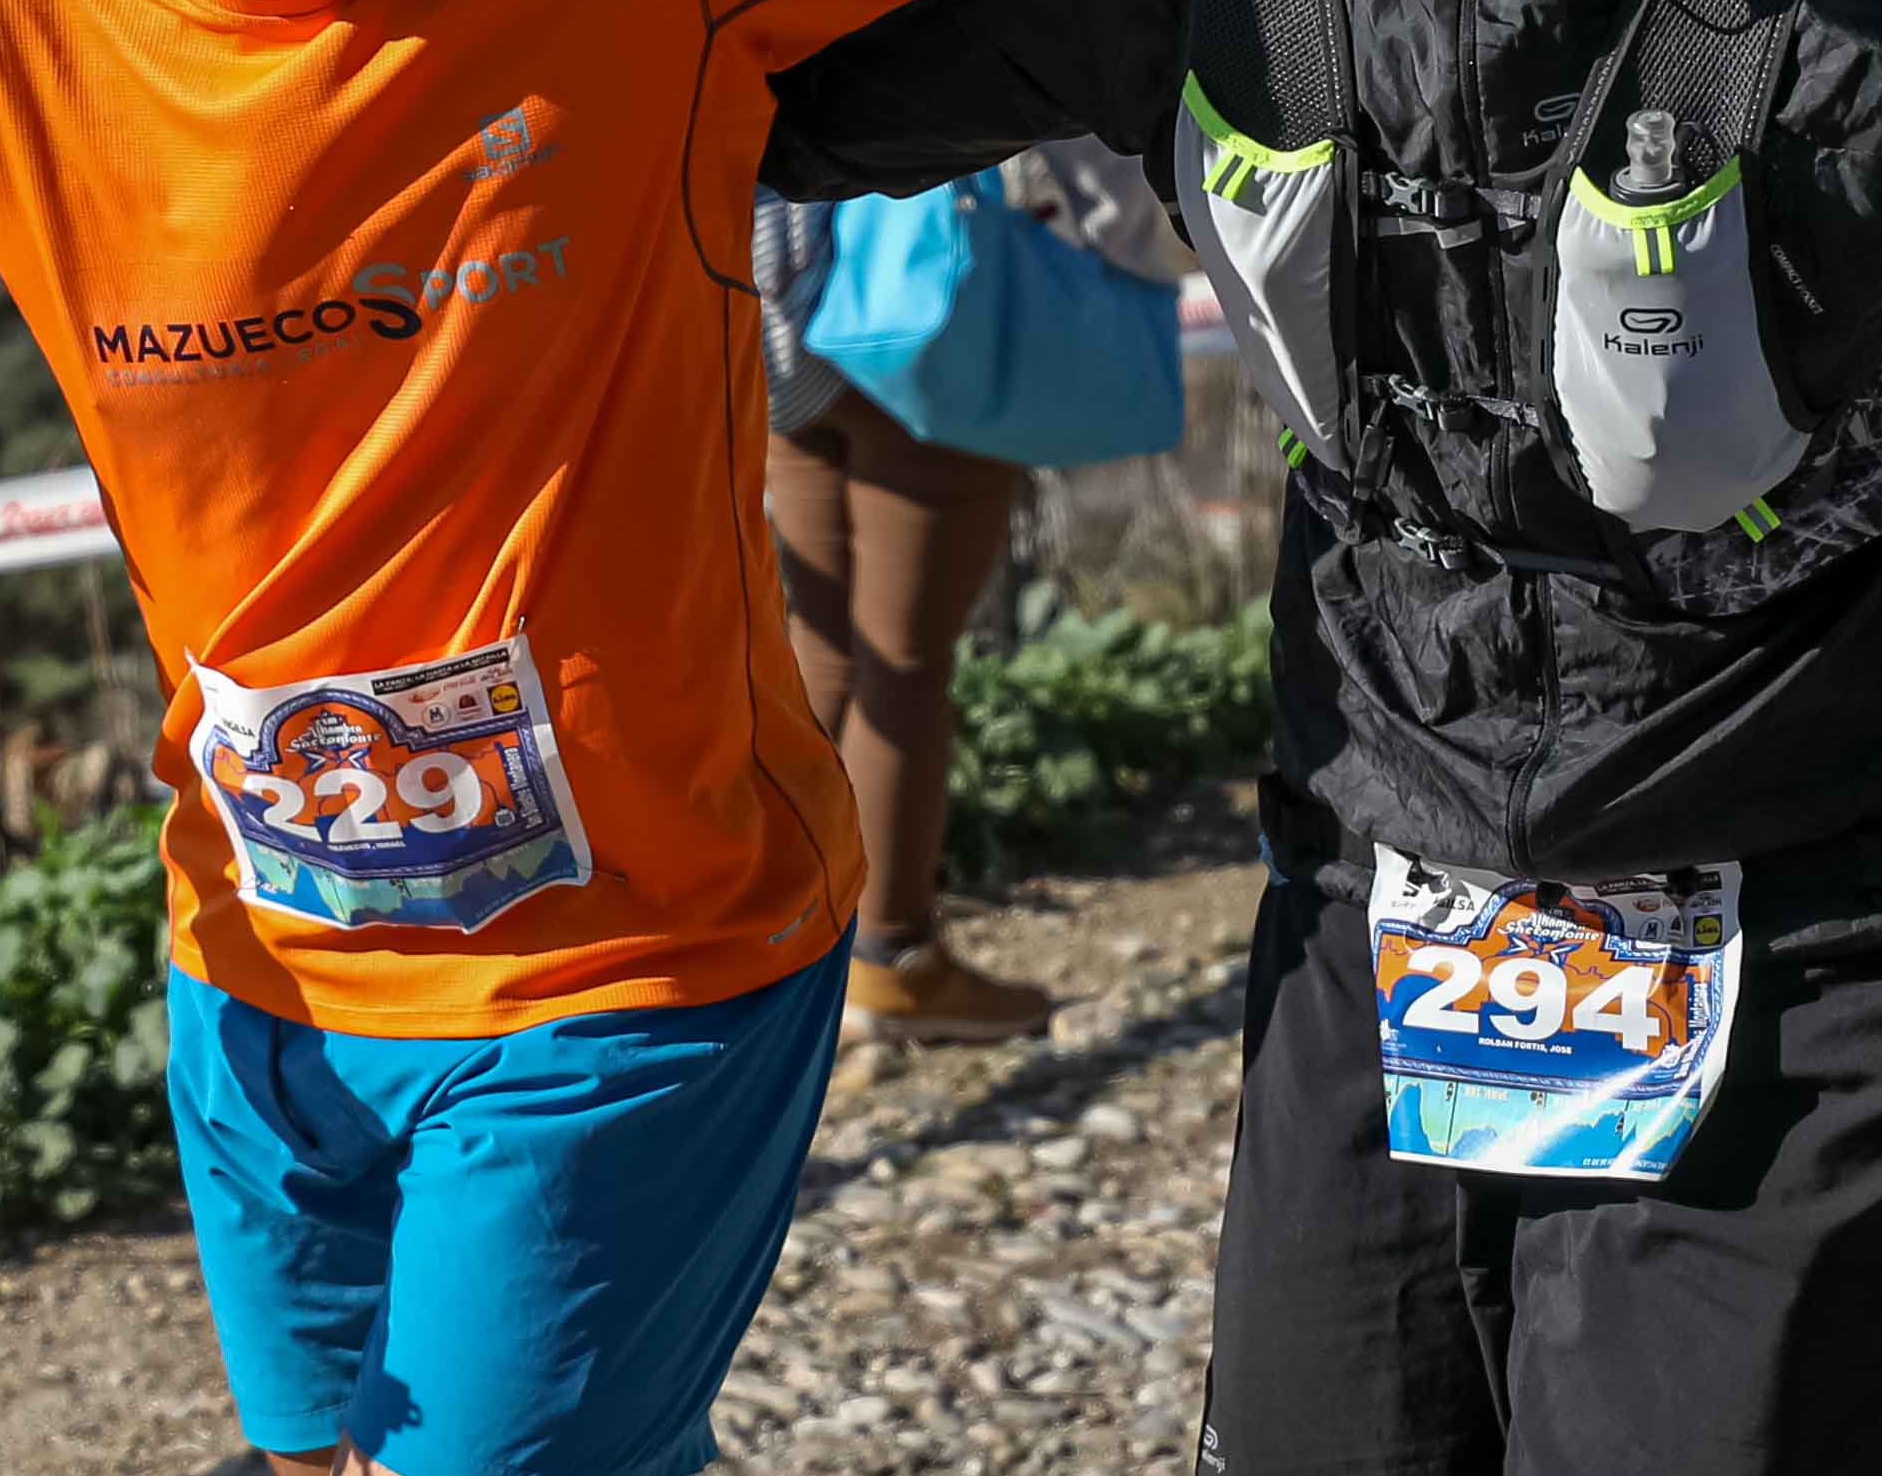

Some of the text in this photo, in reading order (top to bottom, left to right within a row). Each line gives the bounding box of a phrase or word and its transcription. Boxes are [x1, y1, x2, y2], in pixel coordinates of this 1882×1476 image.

[1603, 332, 1705, 358] Kalenji
[242, 751, 483, 844] 229
[1402, 947, 1661, 1051] 294
